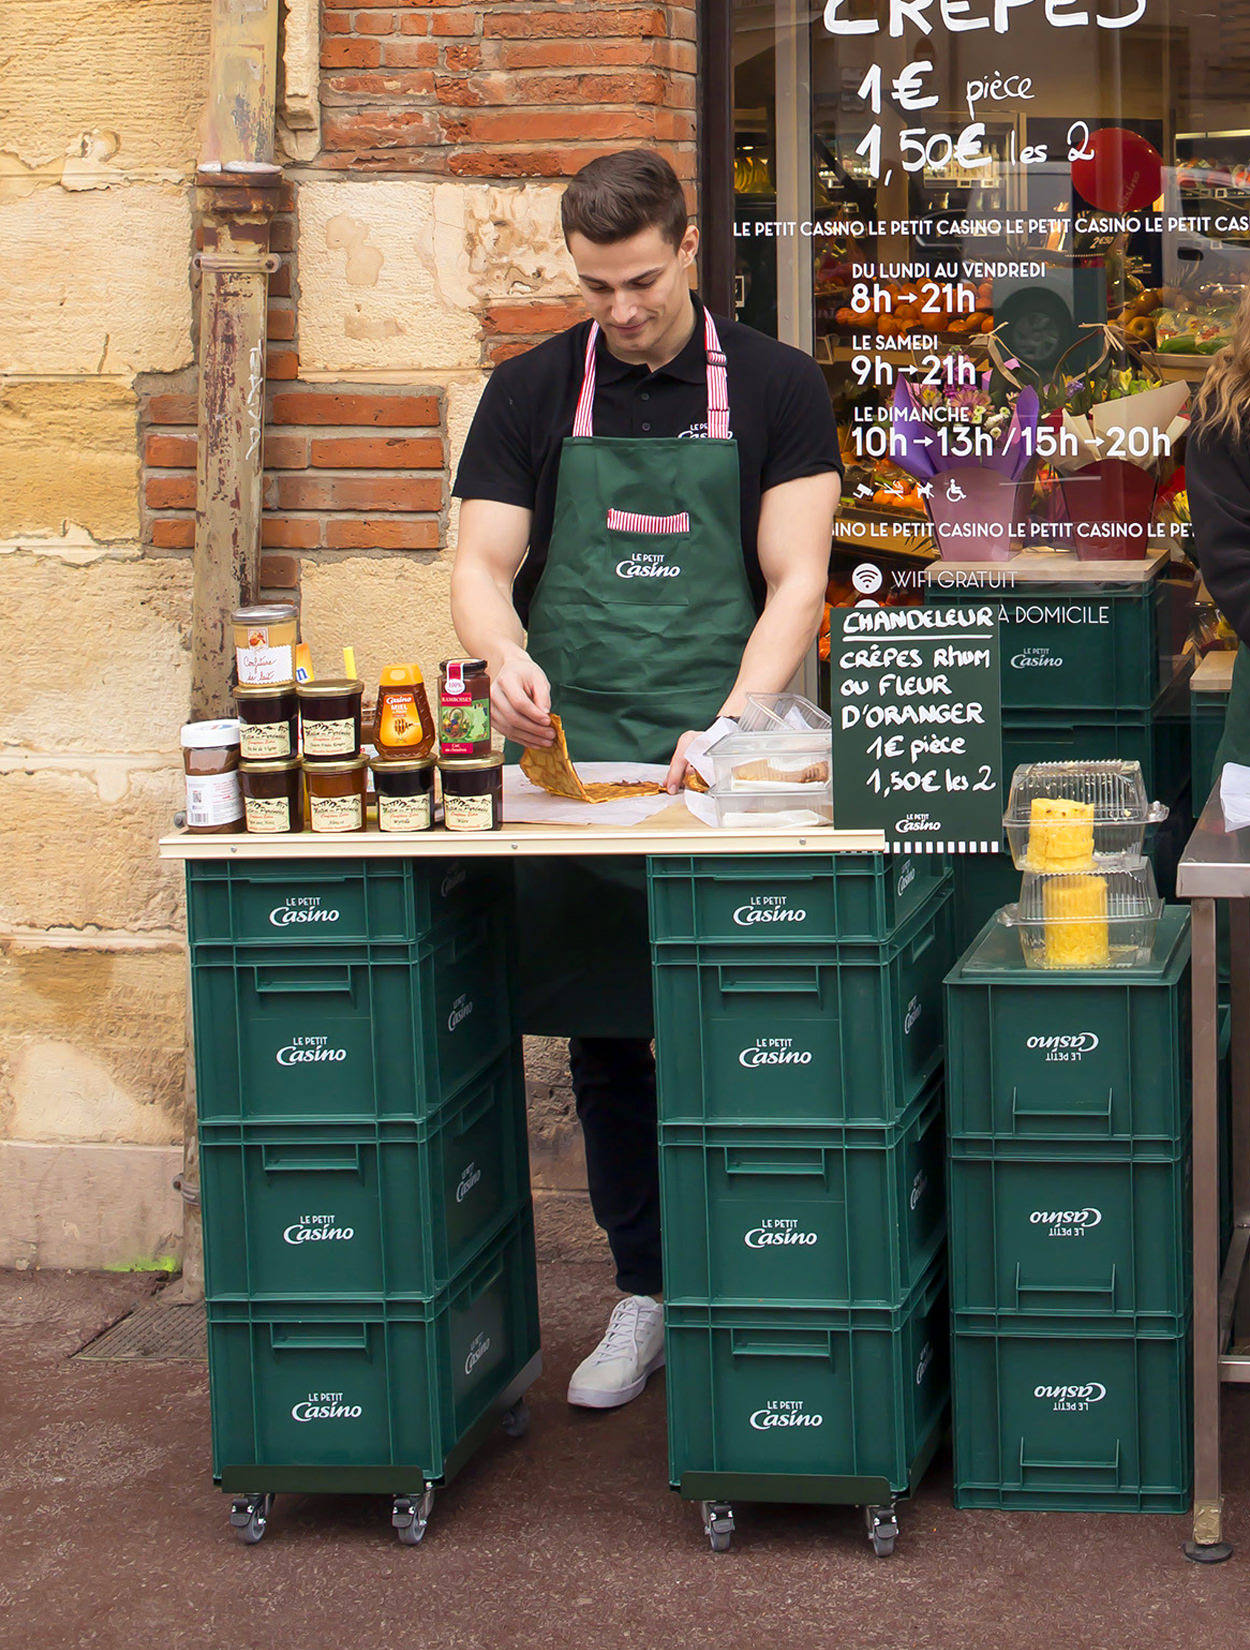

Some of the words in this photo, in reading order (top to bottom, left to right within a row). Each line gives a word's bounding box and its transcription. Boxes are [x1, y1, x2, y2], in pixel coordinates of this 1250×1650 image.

[857, 60, 939, 115] 1€
[965, 70, 1035, 121] pièce
[854, 121, 992, 187] 1,50€
[1010, 129, 1048, 169] les
[1066, 120, 1096, 161] 2
[733, 218, 751, 237] LE
[755, 218, 796, 237] PETIT
[800, 218, 864, 237] CASINO
[869, 217, 885, 236] LE
[890, 217, 932, 236] PETIT
[936, 216, 1001, 236] CASINO
[1006, 216, 1024, 235] LE
[1028, 216, 1071, 235] PETIT
[1074, 215, 1139, 235] CASINO
[1145, 215, 1162, 234] LE
[1166, 214, 1211, 234] PETIT
[851, 262, 875, 279] DU
[880, 262, 930, 278] LUNDI
[934, 262, 958, 278] AU
[962, 261, 1046, 278] VENDREDI
[850, 282, 892, 314] 8h
[920, 282, 976, 314] 21h
[852, 335, 870, 351] LE
[874, 334, 939, 351] SAMEDI
[851, 354, 893, 386] 9h
[920, 354, 977, 386] 21h
[854, 406, 872, 422] LE
[877, 406, 970, 422] DIMANCHE
[852, 426, 908, 457] 10h
[936, 426, 995, 457] 13h
[1023, 426, 1079, 457] 15h
[1105, 426, 1171, 457] 20h
[870, 522, 888, 538] LE
[892, 522, 934, 538] PETIT
[938, 522, 1004, 538] CASINO
[1008, 522, 1026, 538] LE
[1030, 522, 1073, 538] PETIT
[1077, 522, 1143, 538] CASINO
[1148, 522, 1166, 538] LE
[630, 553, 642, 563] LE
[642, 553, 665, 563] PETIT
[615, 559, 681, 579] Casino
[891, 570, 929, 588] WIFI
[937, 570, 1018, 588] GRATUIT
[843, 605, 994, 634] CHANDELEUR
[1015, 606, 1109, 625] DOMICILE
[839, 643, 923, 670] CRÊPES
[1010, 654, 1063, 669] Casino
[841, 702, 985, 730] D'ORANGER
[866, 735, 905, 760] 1€
[910, 733, 966, 764] pièce
[866, 768, 942, 798] 1,50€
[945, 768, 969, 793] les
[972, 765, 997, 792] 2
[895, 817, 942, 833] Casino
[285, 897, 297, 907] LE
[297, 897, 321, 906] PETIT
[750, 896, 761, 906] LE
[762, 896, 787, 906] PETIT
[269, 904, 340, 927] Casino
[733, 905, 807, 926] Casino
[292, 1036, 304, 1046] LE
[304, 1036, 328, 1047] PETIT
[756, 1038, 768, 1048] LE
[768, 1038, 793, 1049] PETIT
[1026, 1032, 1099, 1053] Casino
[276, 1044, 347, 1066] Casino
[738, 1046, 812, 1068] Casino
[1045, 1052, 1069, 1061] PETIT
[1070, 1052, 1082, 1061] LE
[299, 1215, 311, 1225] LE
[311, 1215, 335, 1224] PETIT
[761, 1219, 773, 1229] LE
[774, 1219, 798, 1229] PETIT
[1029, 1207, 1102, 1230] Casino
[283, 1222, 354, 1245] Casino
[744, 1227, 818, 1249] Casino
[1048, 1227, 1072, 1237] PETIT
[1073, 1227, 1085, 1237] LE
[308, 1392, 319, 1402] LE
[320, 1392, 343, 1402] PETIT
[1033, 1382, 1107, 1403] Casino
[291, 1401, 362, 1422] Casino
[767, 1400, 778, 1410] LE
[779, 1400, 804, 1410] PETIT
[1052, 1401, 1077, 1411] PETIT
[1078, 1402, 1089, 1411] LE
[749, 1409, 823, 1430] Casino
